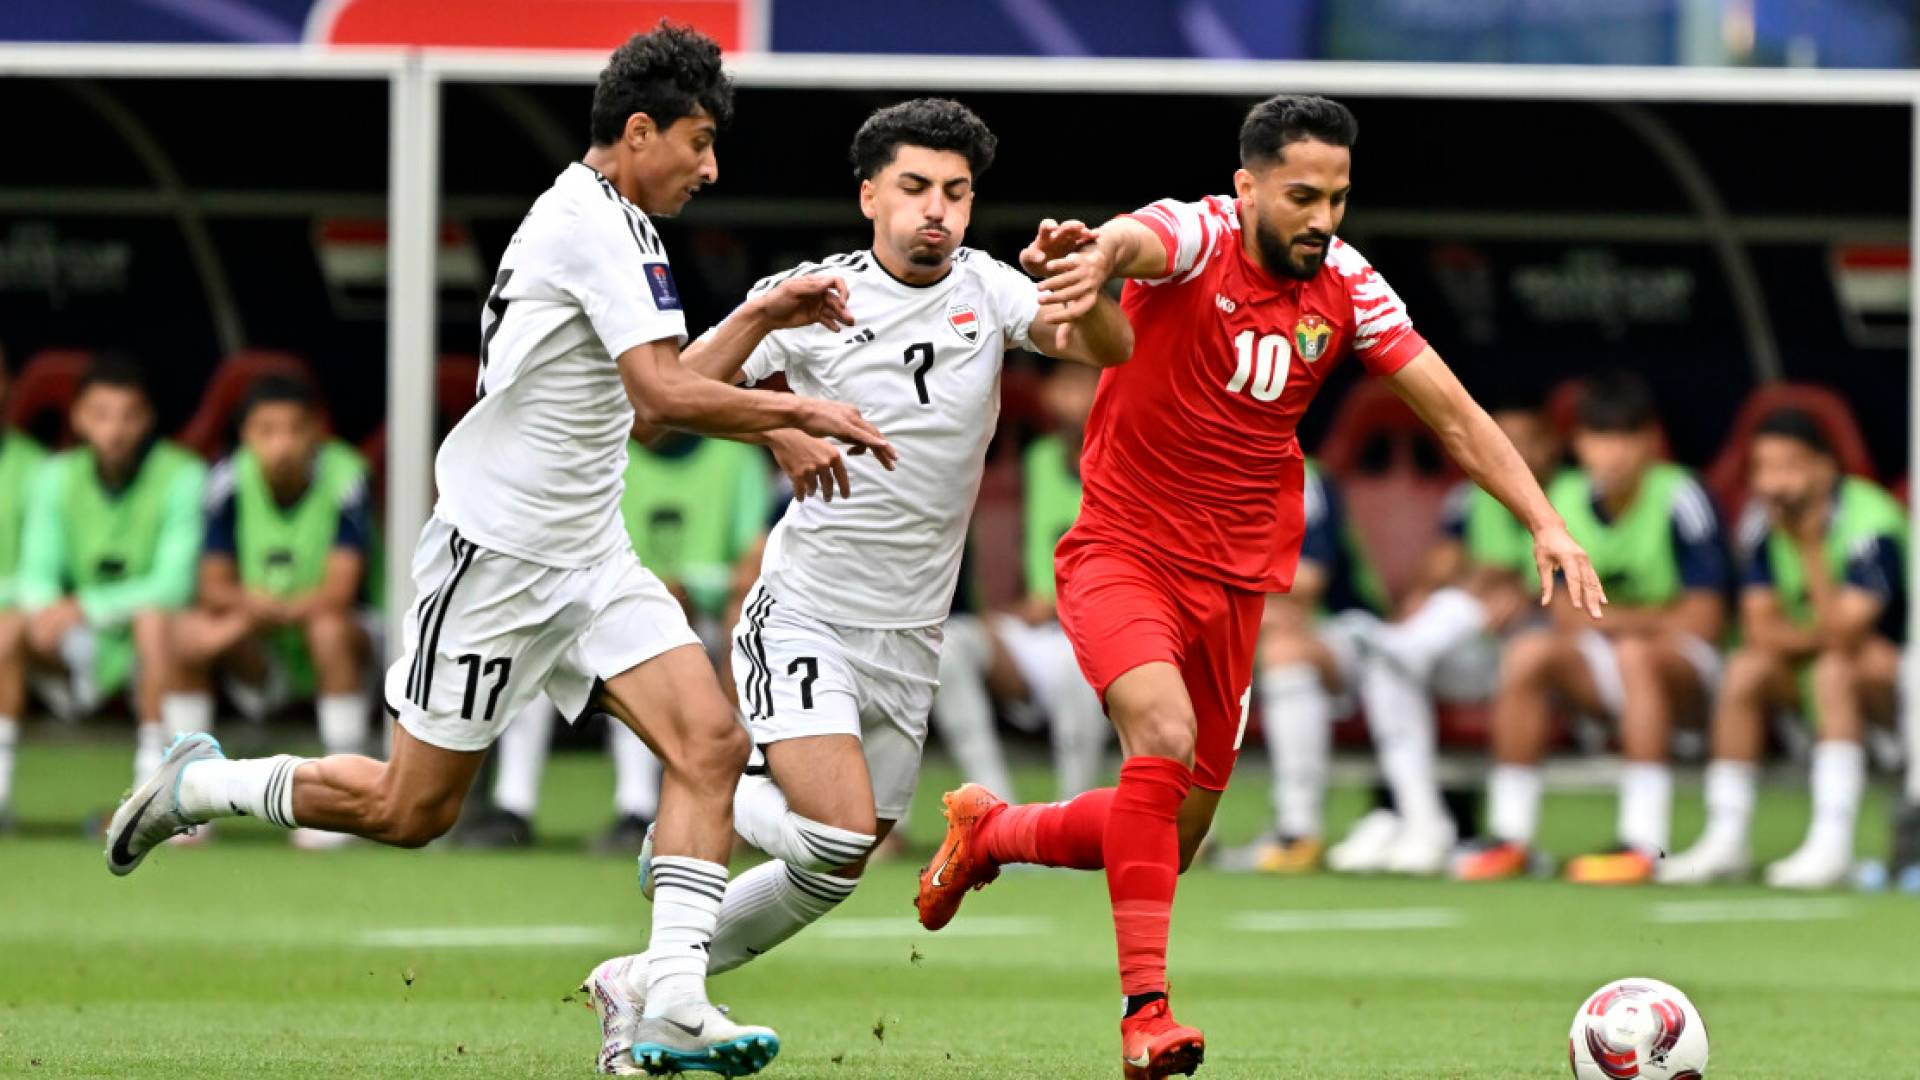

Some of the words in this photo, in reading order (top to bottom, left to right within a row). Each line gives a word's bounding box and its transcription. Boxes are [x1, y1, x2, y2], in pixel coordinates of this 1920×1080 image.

[903, 342, 934, 404] 7
[1225, 329, 1292, 402] 10
[458, 653, 512, 720] 17
[787, 656, 819, 710] 7
